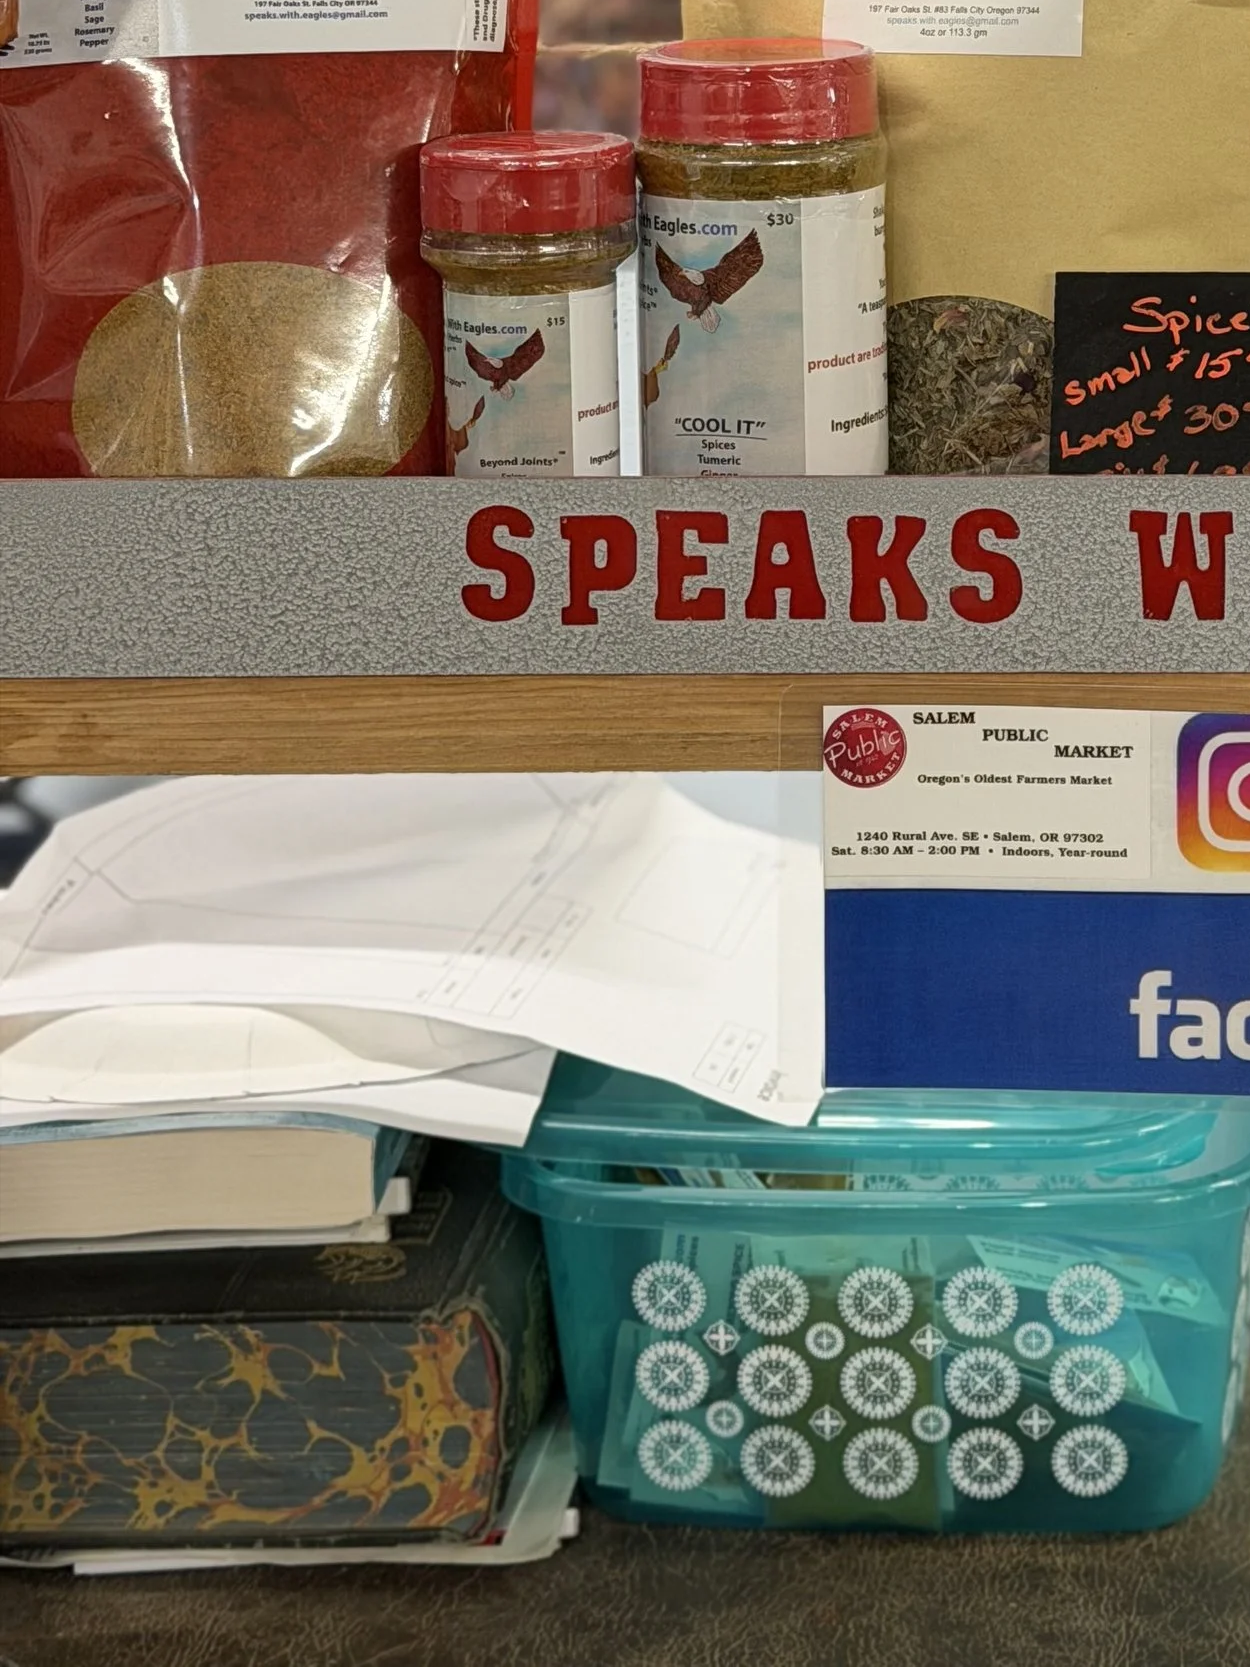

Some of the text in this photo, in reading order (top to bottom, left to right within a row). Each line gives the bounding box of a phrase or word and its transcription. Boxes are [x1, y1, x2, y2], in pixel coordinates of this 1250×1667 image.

[85, 3, 104, 12] Basil
[85, 16, 104, 25] Sage
[75, 26, 114, 36] Rosemary
[80, 38, 109, 48] Pepper
[654, 216, 737, 236] Eagles.com
[767, 213, 794, 226] $30
[464, 322, 527, 335] Eagles.com
[547, 317, 565, 327] $15
[1064, 346, 1151, 405] small
[1060, 410, 1155, 459] Large
[702, 440, 736, 452] Spices
[480, 457, 518, 468] Beyond
[697, 454, 741, 465] Tumeric
[461, 505, 1023, 628] SPEAKS
[913, 712, 976, 724] SALEM
[832, 713, 888, 740] SALEM
[982, 729, 1049, 742] PUBLIC
[824, 729, 900, 768] Public
[1054, 745, 1134, 758] MARKET
[840, 752, 900, 784] MARKET
[918, 774, 1112, 786] Oregon's Oldest Farmers Market
[856, 832, 1103, 844] 1240 Rural Ave. SE Salem, OR 97302
[831, 846, 1127, 859] Sat. 8:30 AM 2:00 PM Indoors, Year-round
